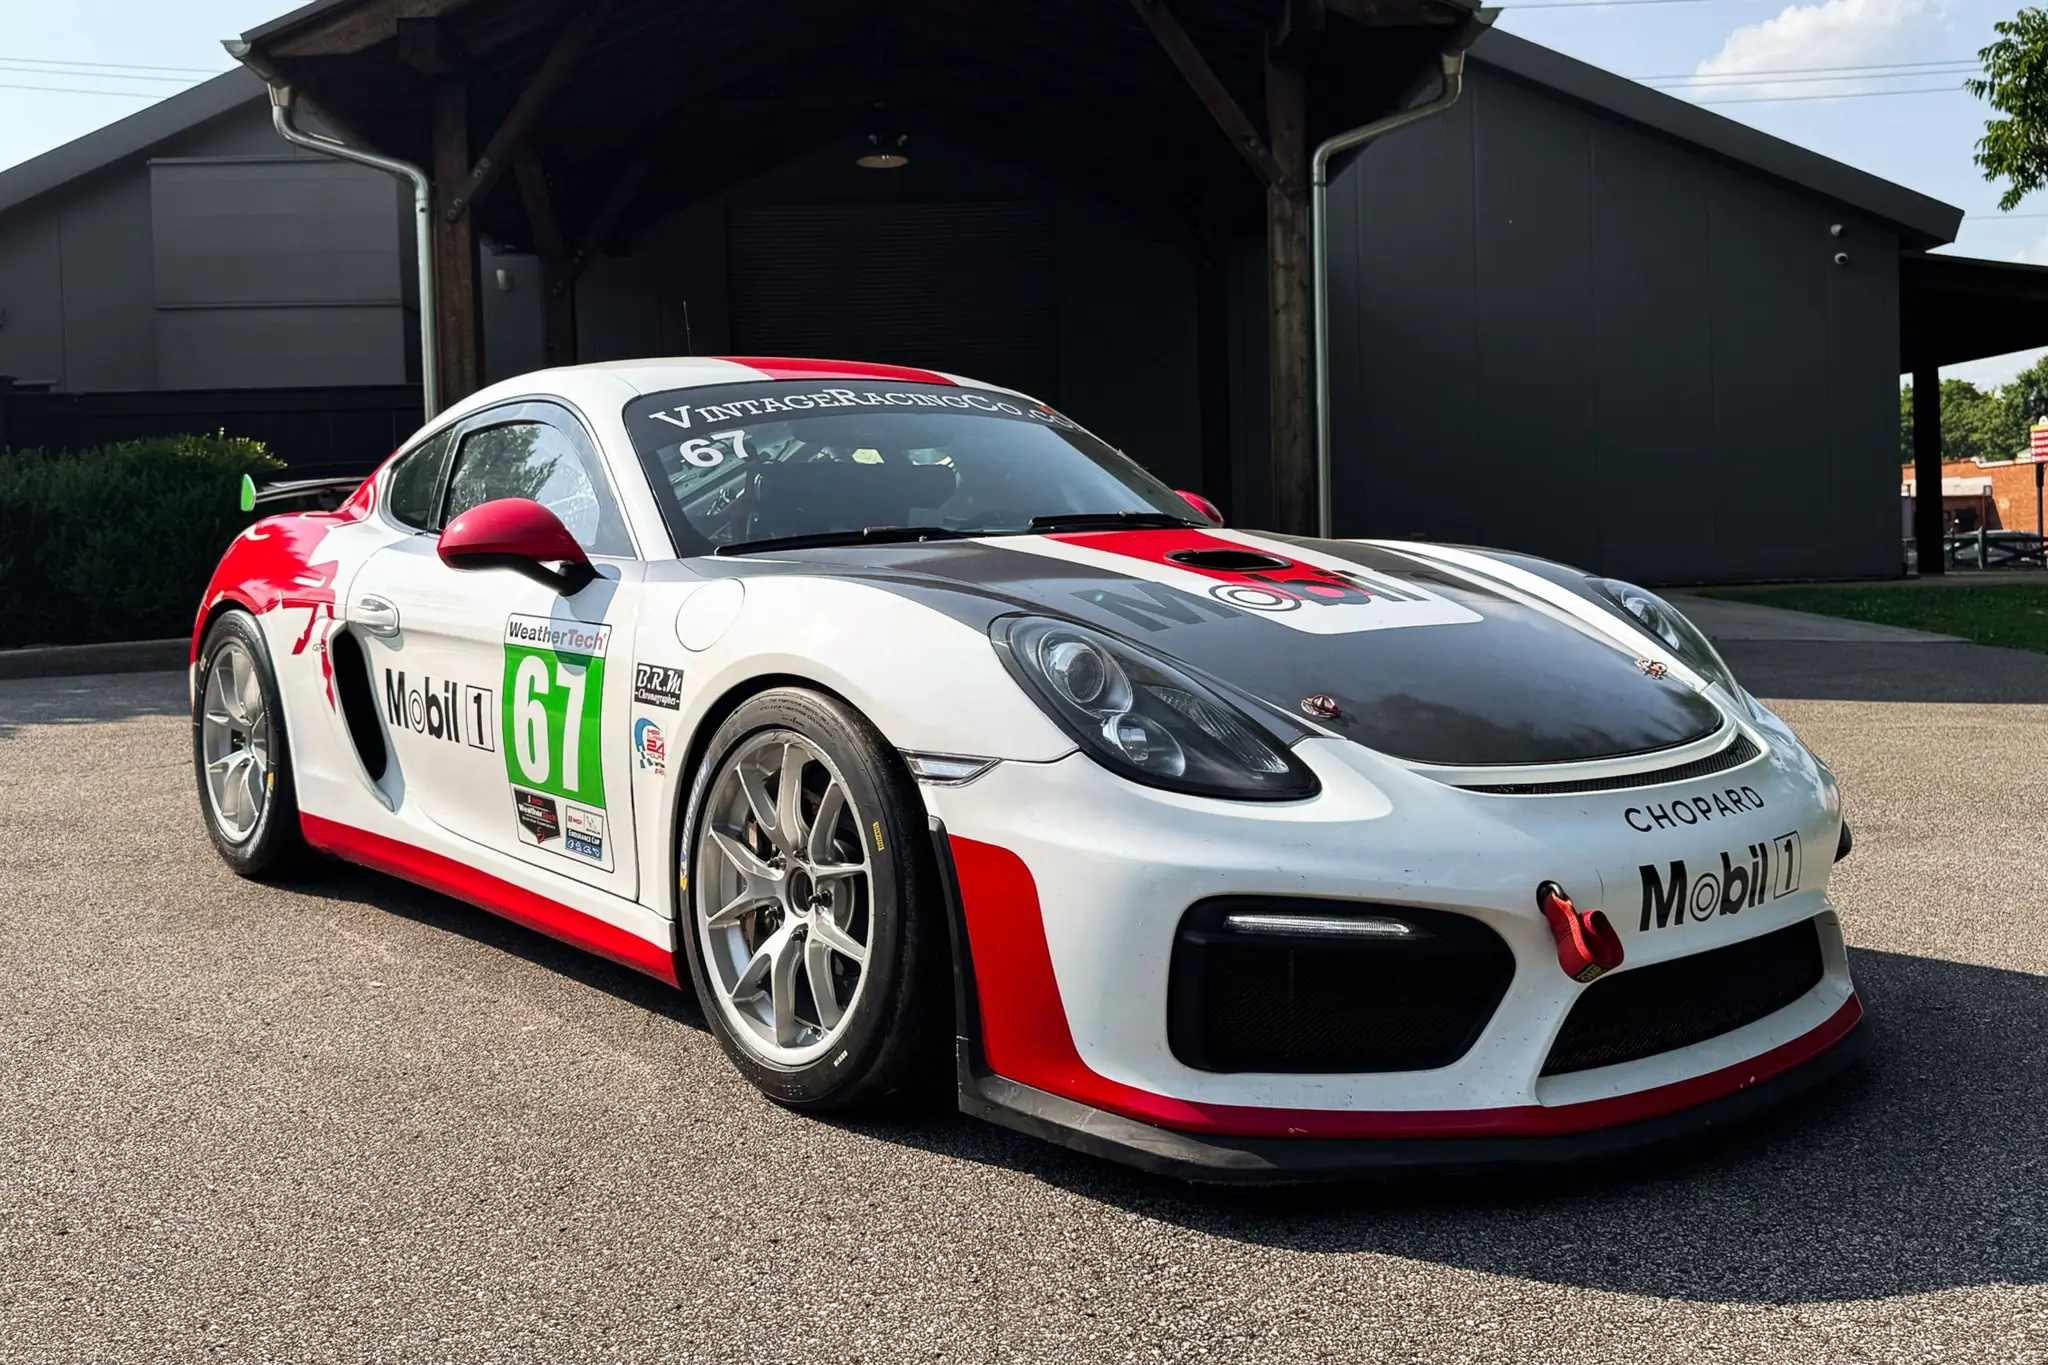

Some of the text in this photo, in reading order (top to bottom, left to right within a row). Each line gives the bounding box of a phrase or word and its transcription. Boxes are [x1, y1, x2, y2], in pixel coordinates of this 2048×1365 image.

[679, 429, 749, 468] 67
[1069, 569, 1431, 632] Mobil
[509, 620, 605, 650] WeatherTech
[385, 668, 460, 743] Mobil
[513, 655, 587, 793] 67
[1624, 785, 1765, 833] CHOPARD
[1639, 842, 1768, 932] Mobil
